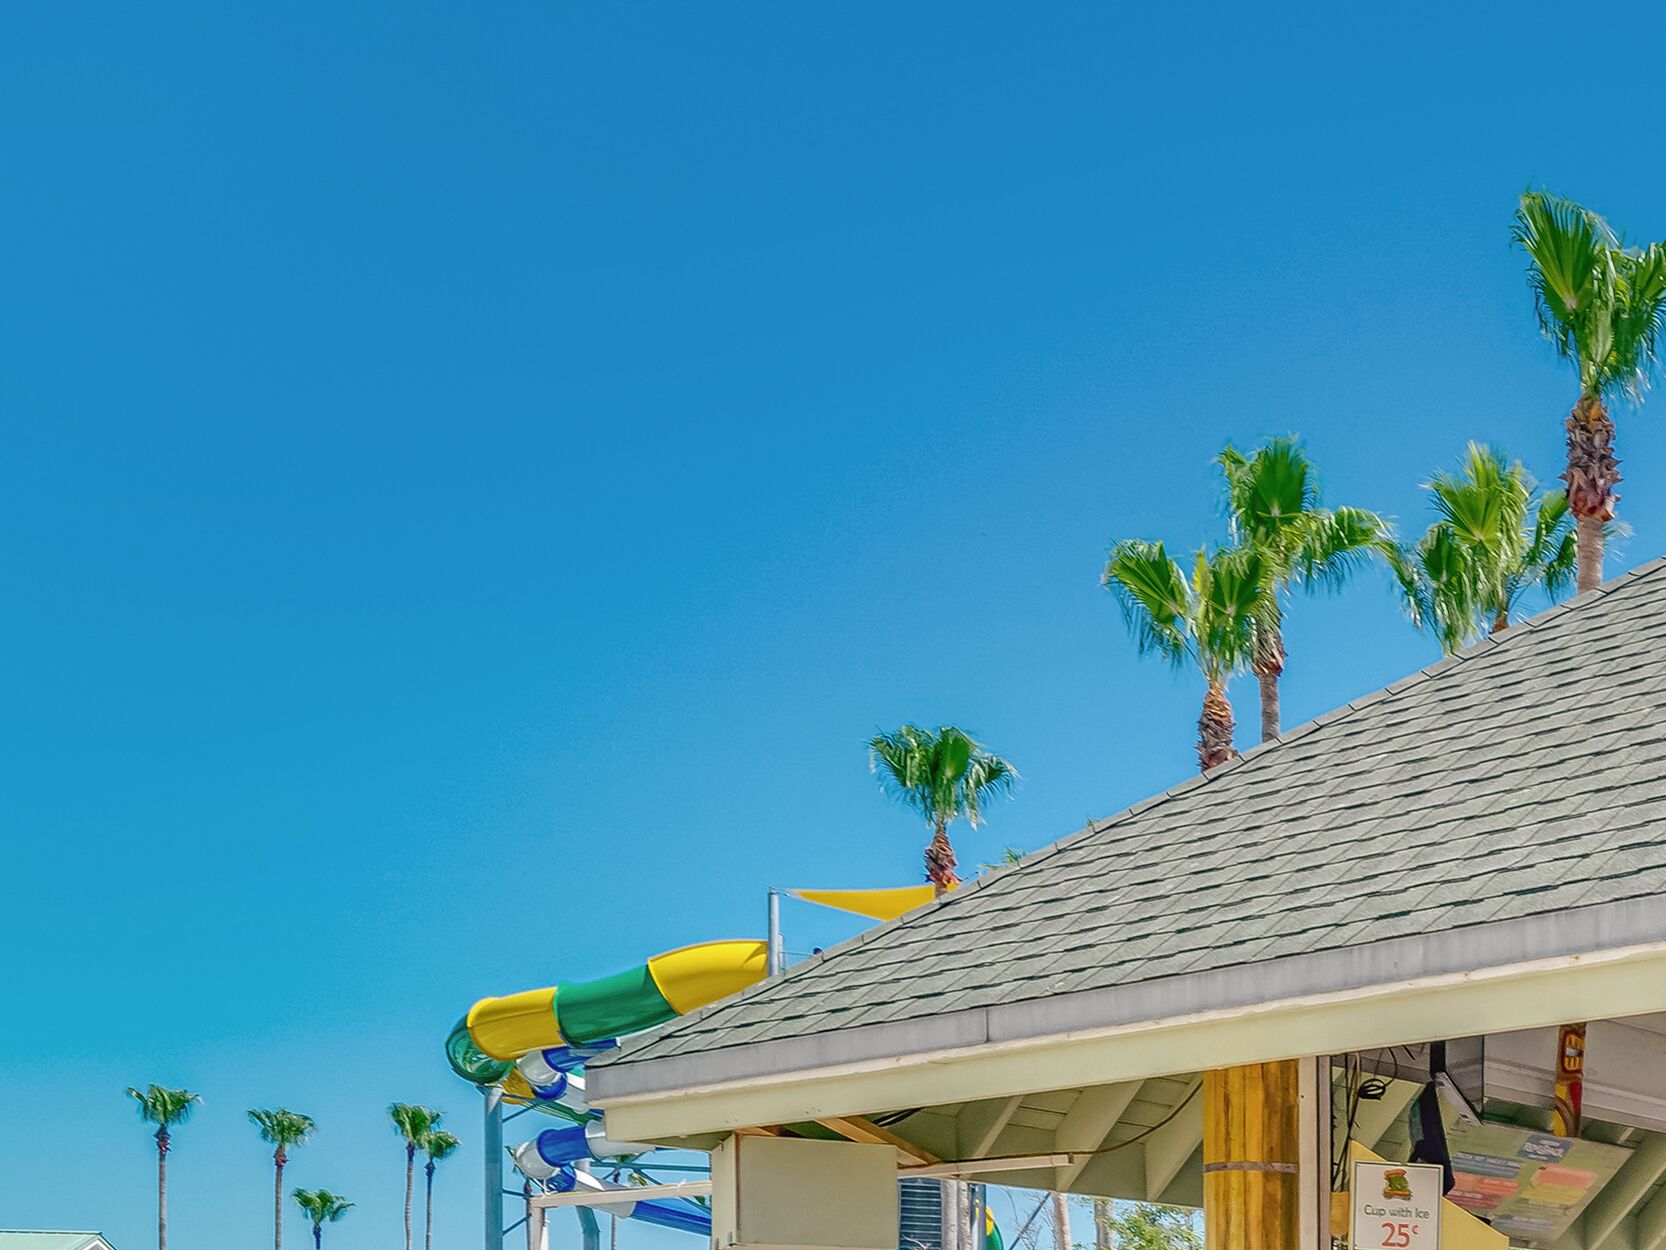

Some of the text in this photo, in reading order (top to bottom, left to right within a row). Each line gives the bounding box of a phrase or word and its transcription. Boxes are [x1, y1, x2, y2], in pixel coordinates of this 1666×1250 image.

[1363, 1204, 1431, 1219] Cup with Ice
